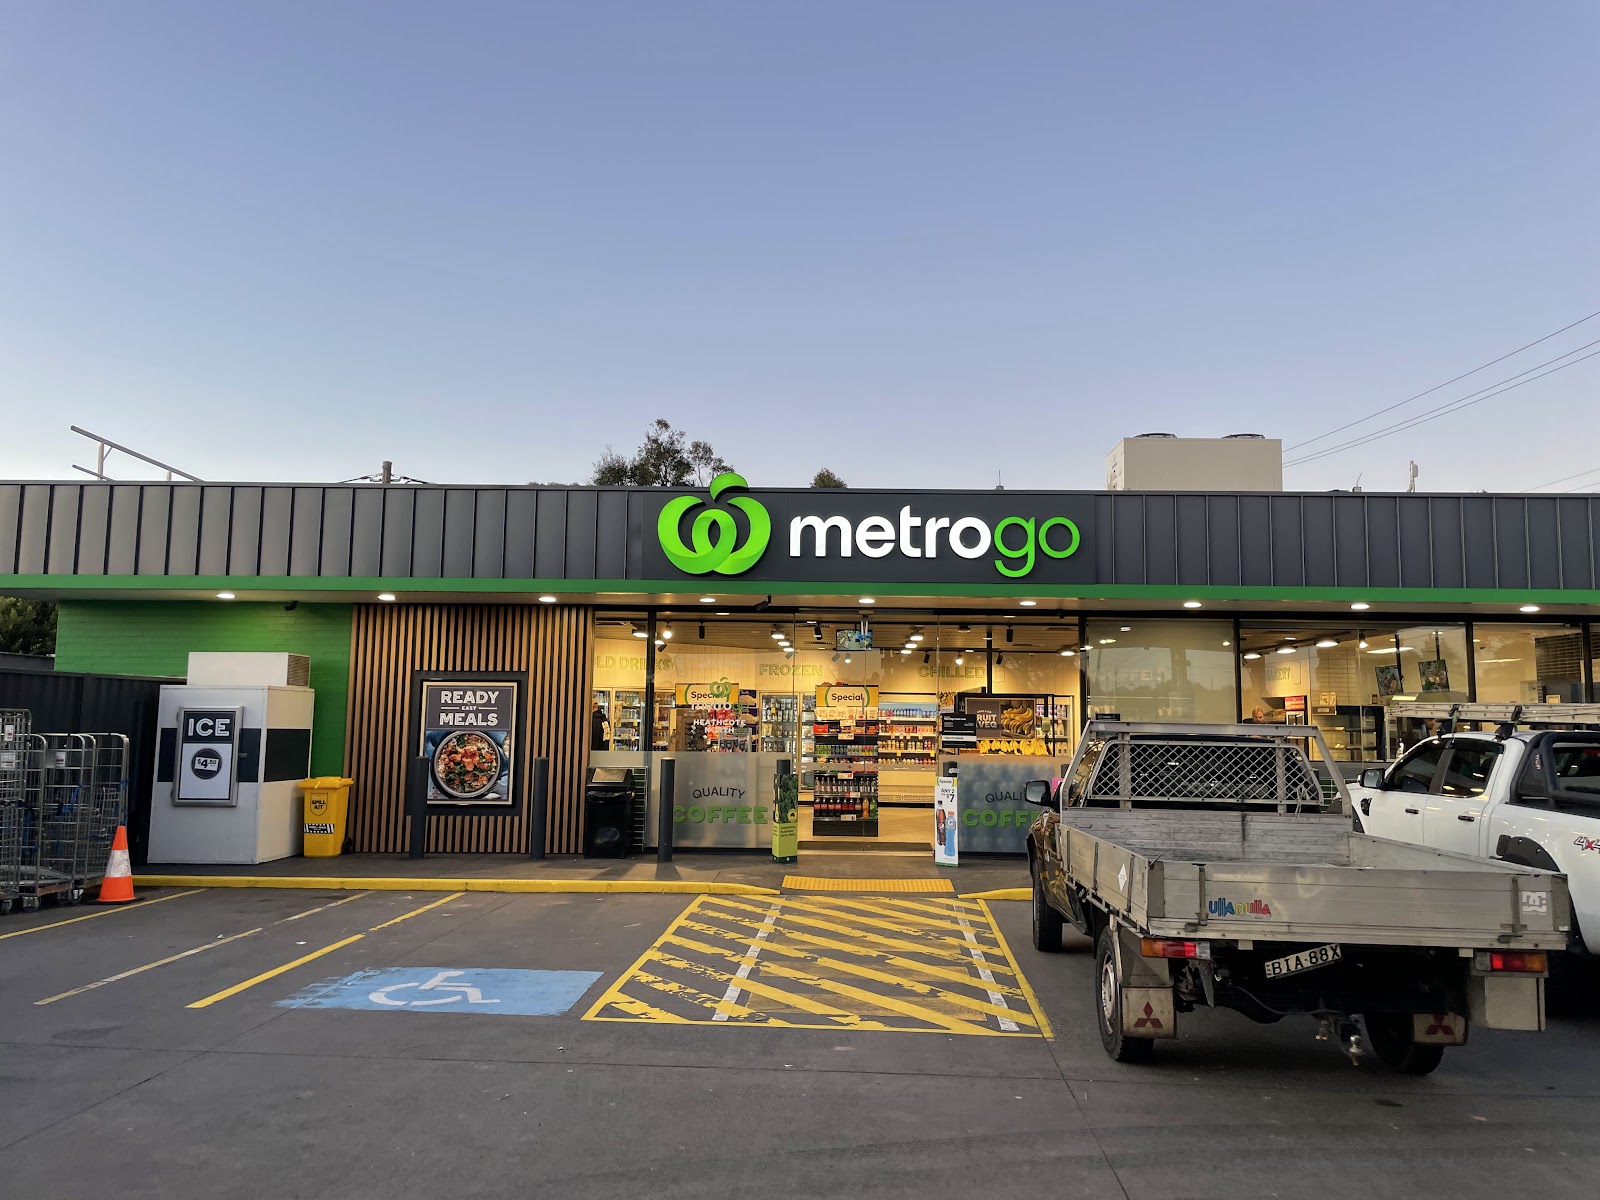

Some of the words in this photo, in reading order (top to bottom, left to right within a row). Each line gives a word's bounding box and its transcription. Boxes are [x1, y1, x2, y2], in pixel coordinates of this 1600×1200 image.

[789, 505, 1080, 577] metrogo
[619, 656, 671, 671] DRIKS
[759, 664, 823, 676] FROZEN
[918, 666, 986, 678] CHILLED
[440, 690, 499, 704] READY
[831, 693, 863, 702] Special
[439, 712, 498, 726] MEALS
[977, 714, 997, 722] RUIT
[188, 718, 230, 736] ICE
[692, 786, 746, 799] QUALITY
[985, 791, 1023, 803] QUALI
[673, 805, 769, 824] COFFEE
[962, 808, 1041, 828] COFF
